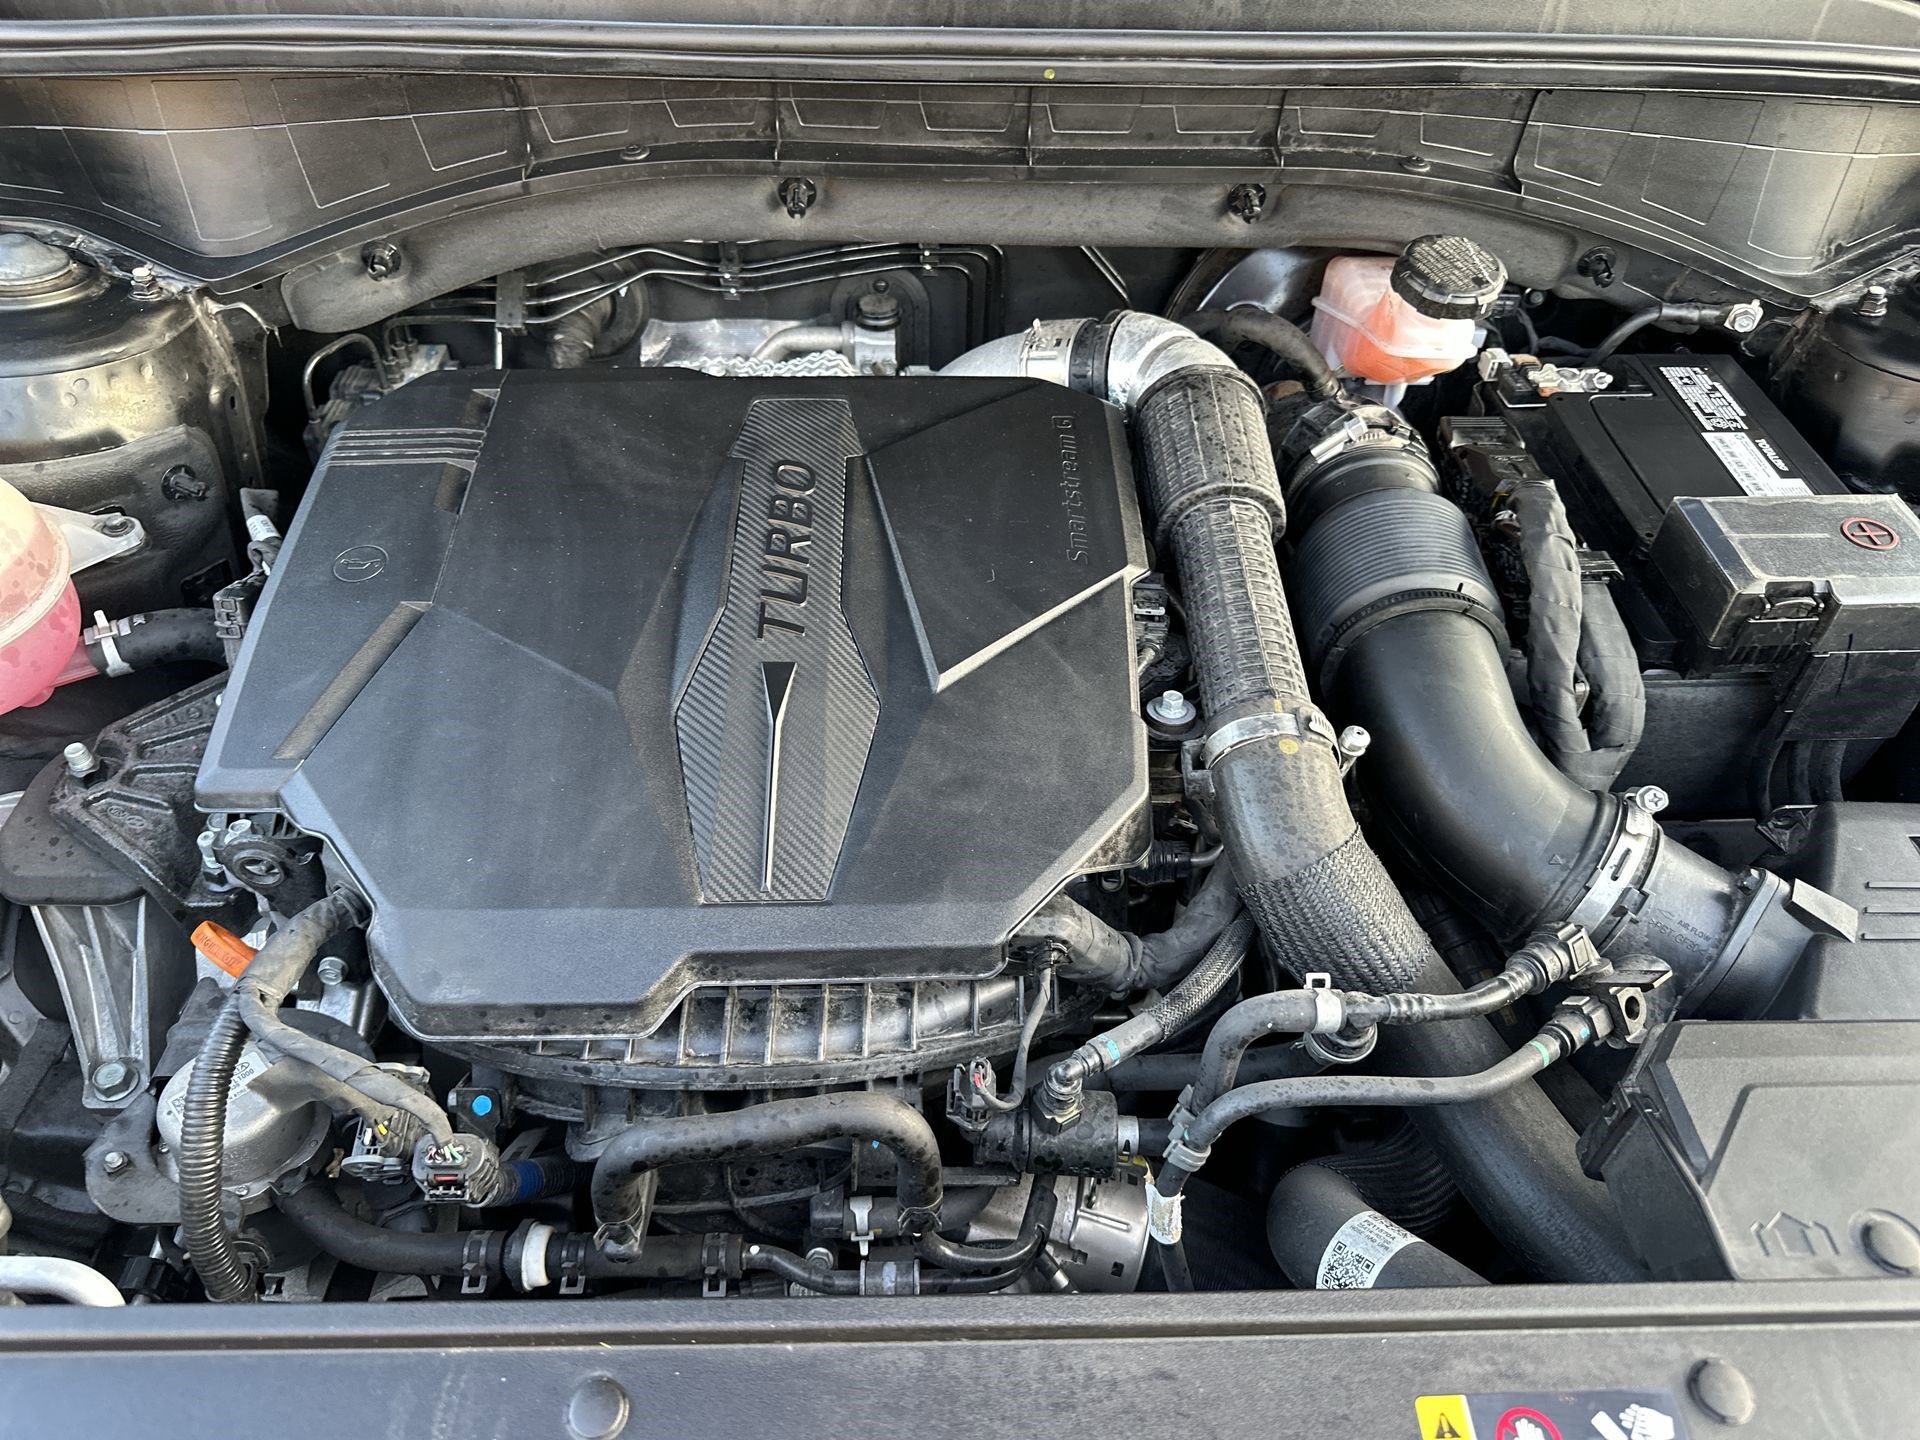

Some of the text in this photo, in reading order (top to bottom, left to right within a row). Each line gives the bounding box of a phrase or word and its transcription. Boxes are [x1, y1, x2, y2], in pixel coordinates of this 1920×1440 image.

[756, 459, 817, 642] TURBO
[1058, 433, 1090, 566] Smartstream
[1677, 919, 1712, 941] AIR FLOW
